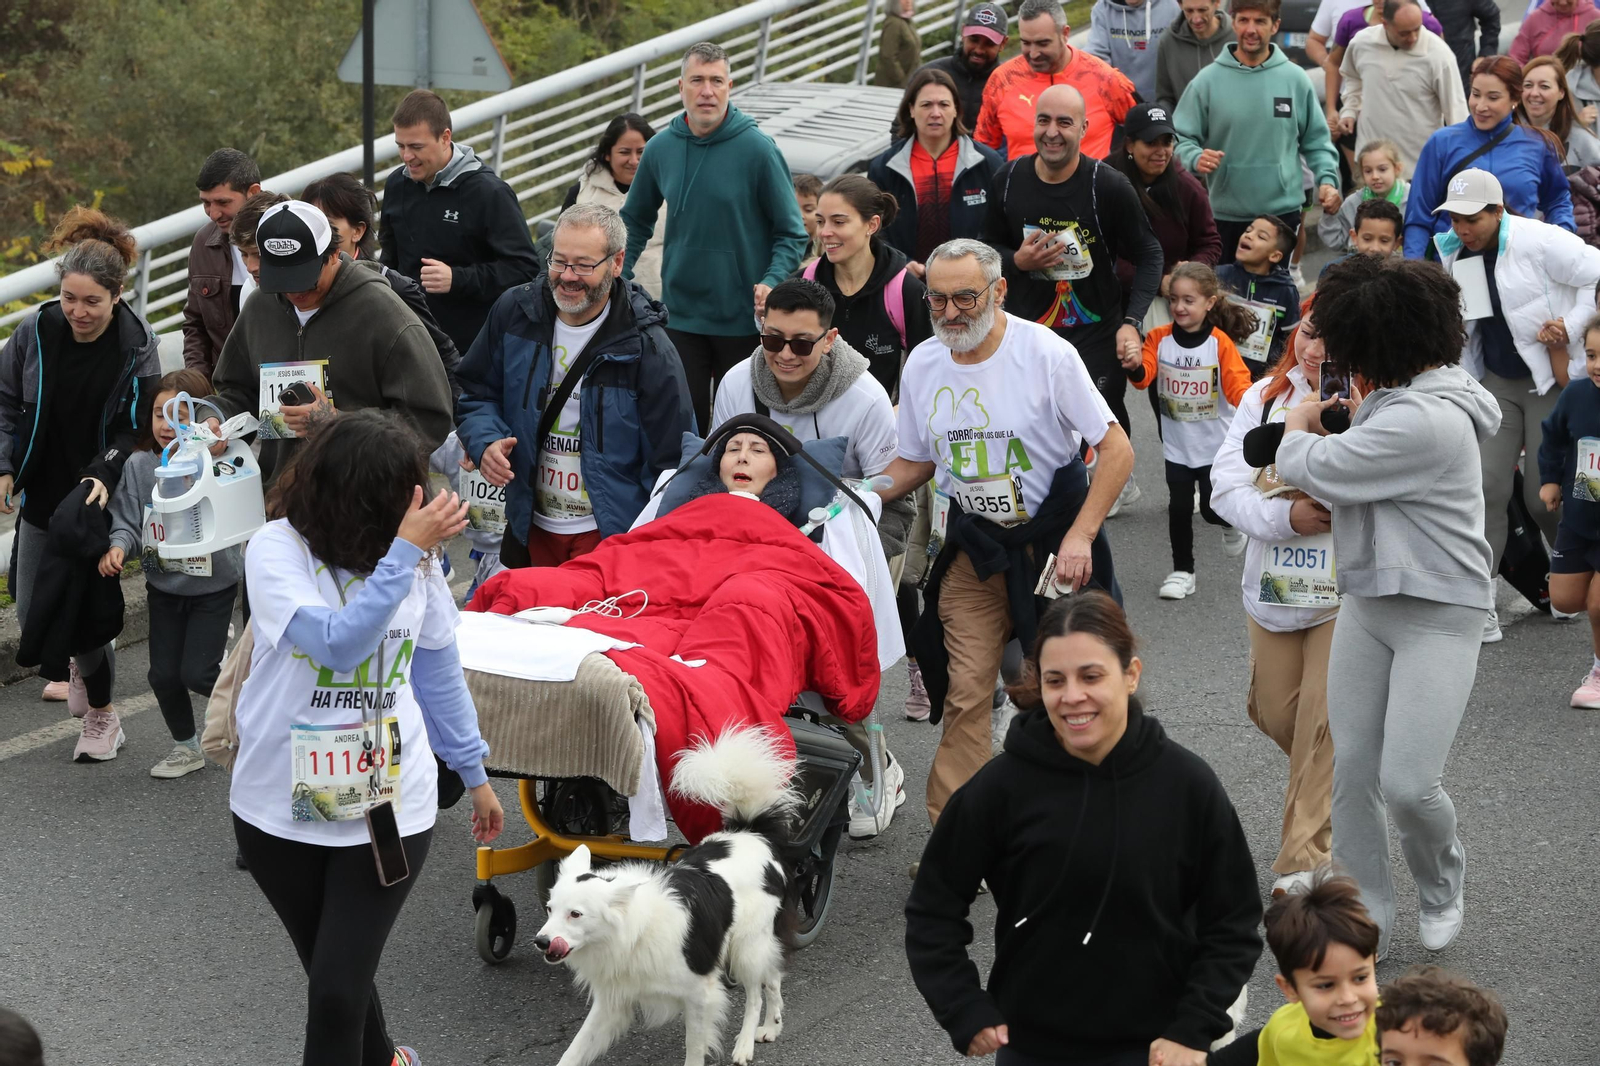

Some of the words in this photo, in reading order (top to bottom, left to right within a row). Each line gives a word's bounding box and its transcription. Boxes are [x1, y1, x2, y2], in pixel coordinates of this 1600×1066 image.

[1450, 178, 1468, 195] NY
[1166, 378, 1208, 396] 10730
[948, 428, 973, 442] CORRO
[994, 430, 1005, 438] QUE
[950, 438, 1033, 479] ELA
[956, 491, 1011, 513] 11355
[1273, 546, 1326, 570] 12051
[389, 629, 402, 639] QUE
[403, 628, 410, 638] LA
[310, 690, 332, 708] HA
[334, 734, 360, 744] ANDREA
